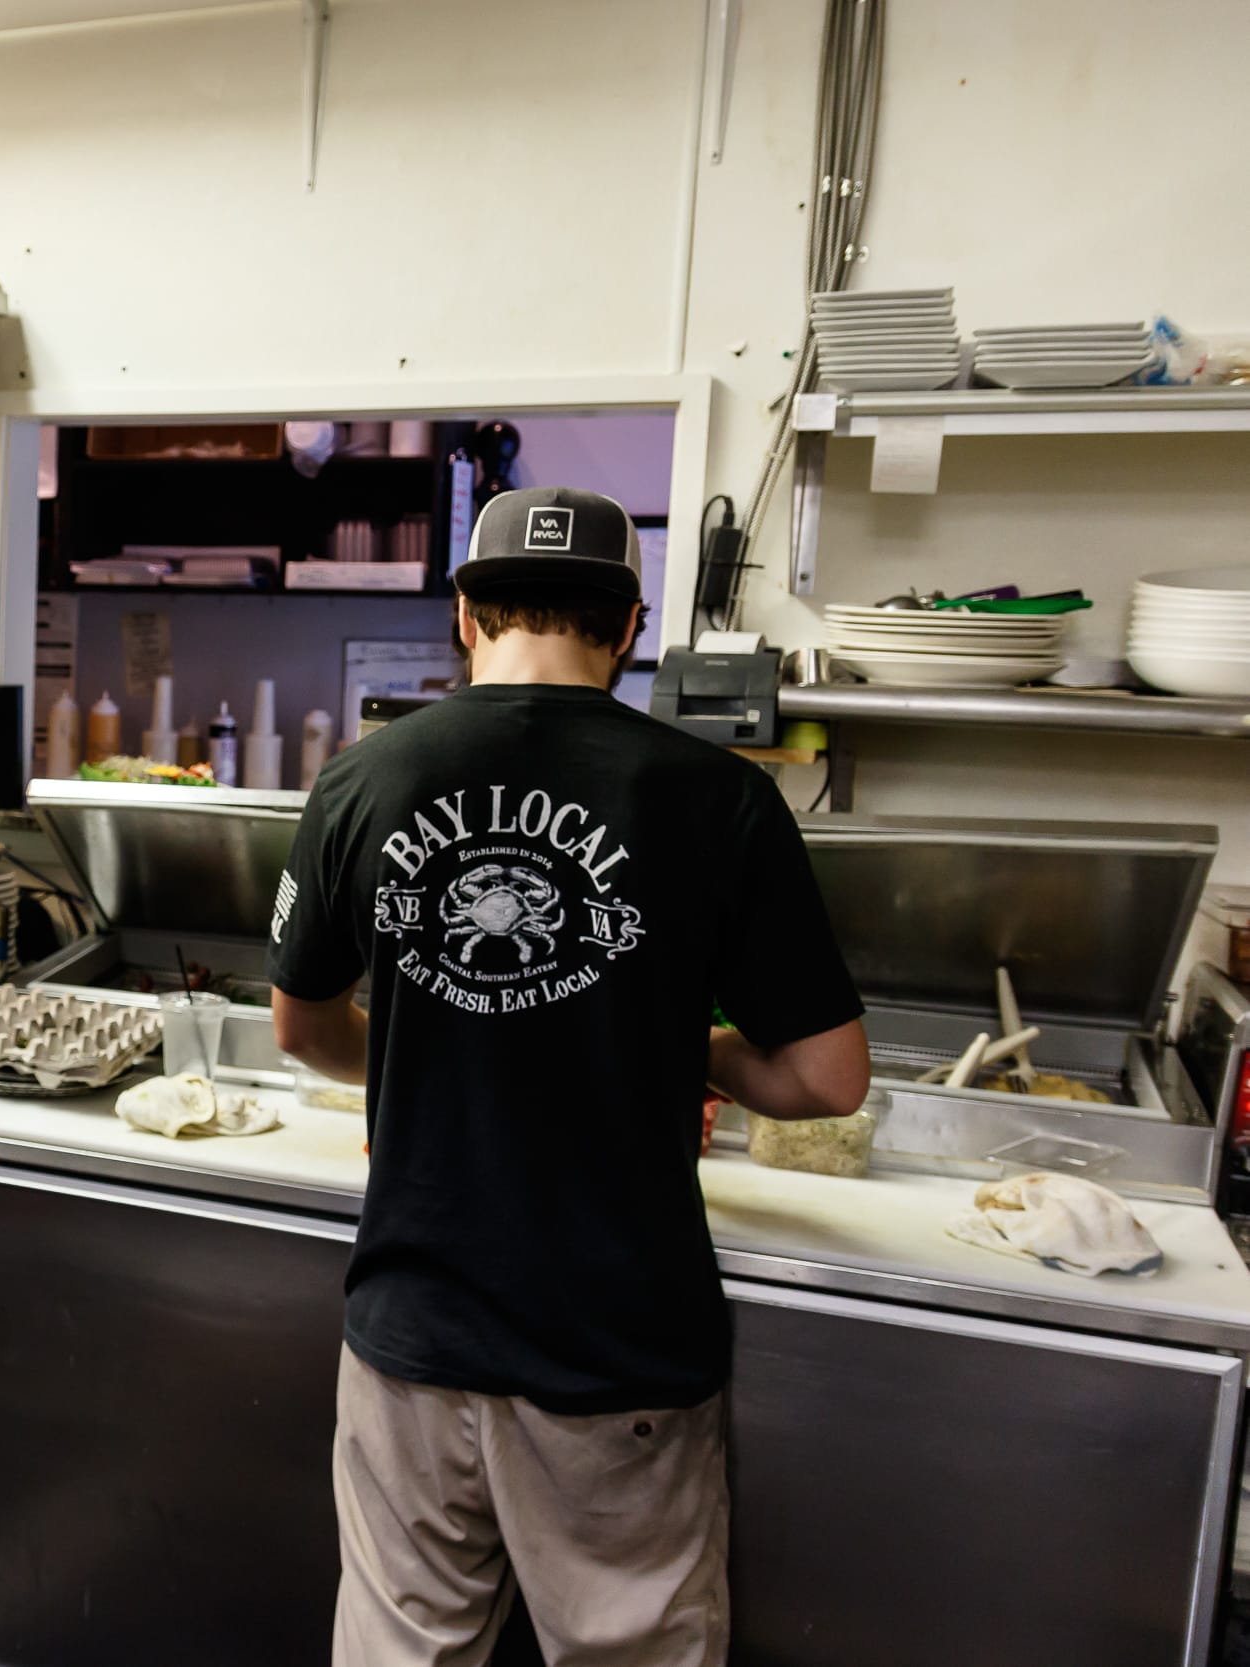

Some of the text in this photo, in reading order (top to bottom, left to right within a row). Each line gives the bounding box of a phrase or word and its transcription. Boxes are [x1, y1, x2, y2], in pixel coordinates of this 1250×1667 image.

[381, 785, 630, 894] BAY LOCAL
[393, 895, 420, 922] VB
[590, 908, 613, 940] VA
[396, 947, 600, 1014] EAT FRESH. EAT LOCAL
